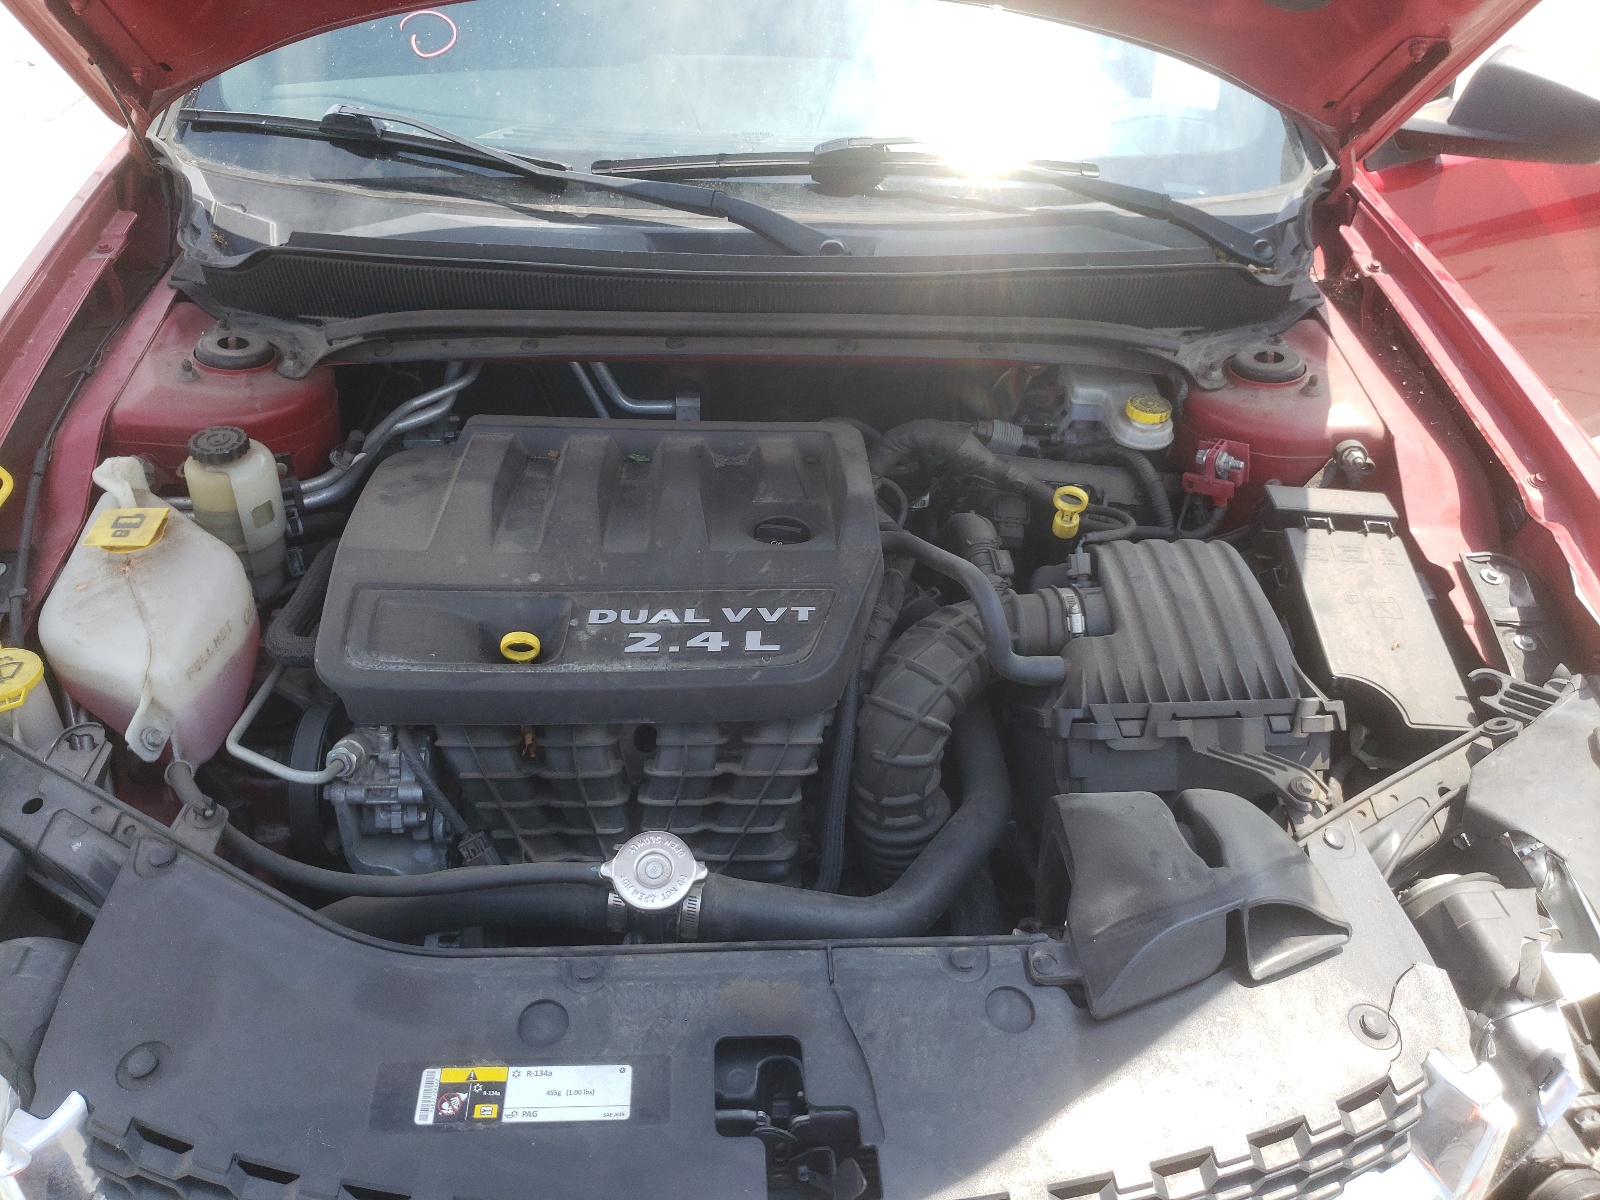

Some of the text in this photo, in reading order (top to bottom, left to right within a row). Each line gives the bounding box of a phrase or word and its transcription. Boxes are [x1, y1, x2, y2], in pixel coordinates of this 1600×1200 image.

[588, 606, 816, 625] DUAL VVT
[624, 630, 781, 653] 2.4 L
[187, 647, 213, 680] FULL
[629, 836, 686, 857] OPEN SLOWLY
[620, 875, 633, 891] HOT
[633, 890, 657, 903] OPEN
[661, 886, 679, 902] NOT
[566, 1089, 583, 1097] (1.00
[522, 1110, 538, 1118] PAG
